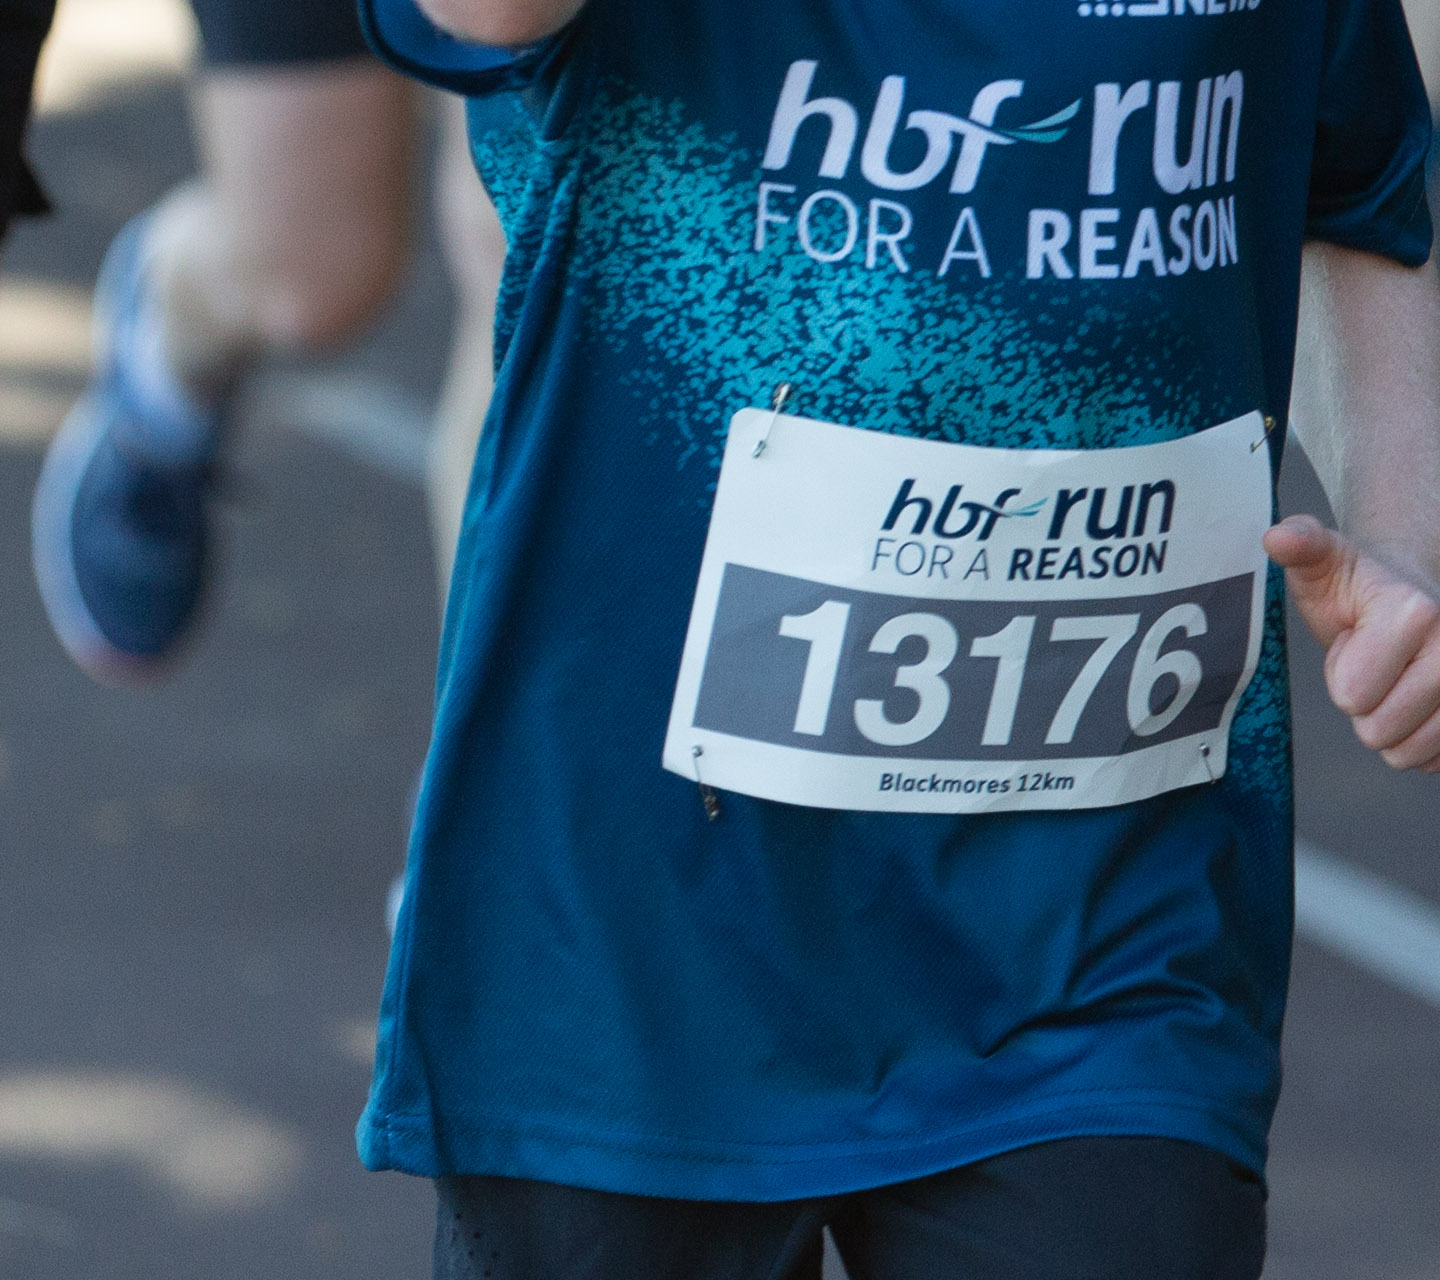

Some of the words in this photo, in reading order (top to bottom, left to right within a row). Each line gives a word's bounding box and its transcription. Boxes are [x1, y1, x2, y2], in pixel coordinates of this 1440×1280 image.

[760, 58, 1025, 195] hbf
[1087, 68, 1244, 196] run
[753, 181, 913, 274] FOR
[937, 206, 992, 278] A
[1025, 195, 1239, 279] REASON
[881, 477, 1021, 541] hbf
[1046, 477, 1178, 541] run
[870, 537, 954, 580] FOR
[963, 546, 991, 581] A
[1007, 540, 1170, 582] REASON
[778, 600, 1209, 748] 13176
[879, 772, 1012, 794] Blackmores
[1016, 772, 1076, 793] 12km
